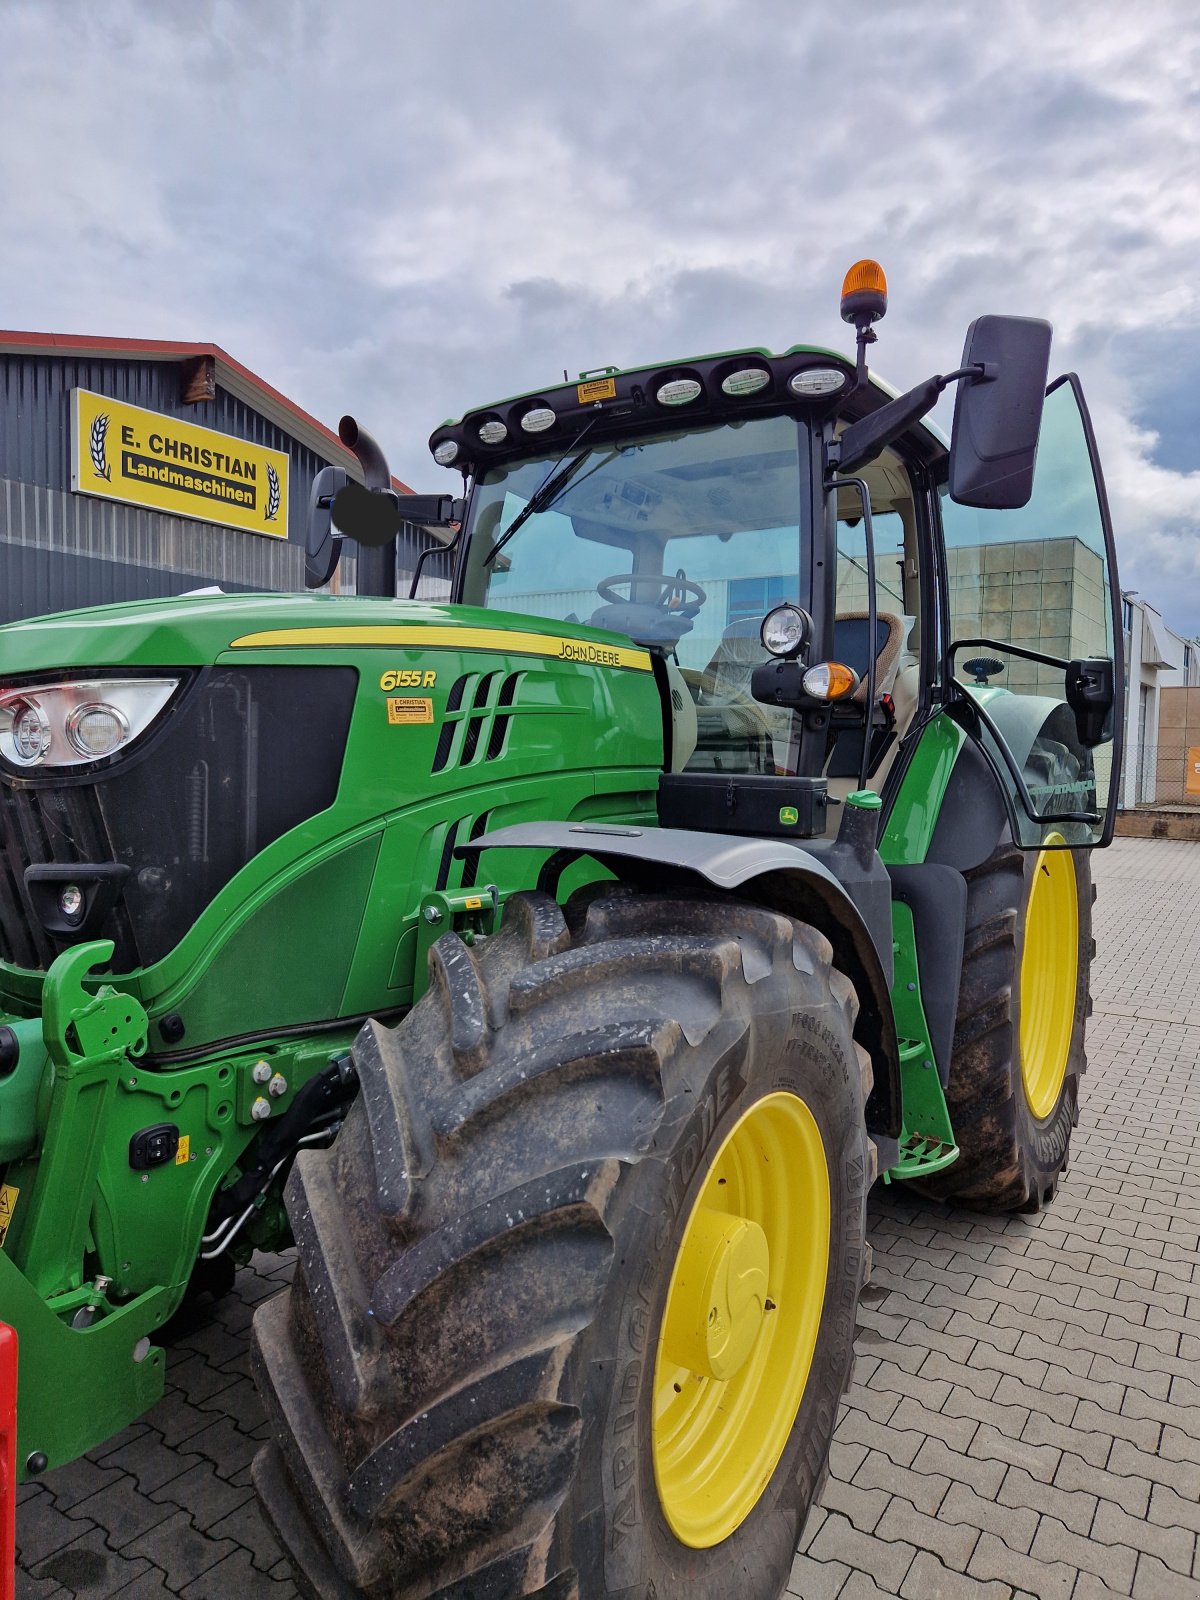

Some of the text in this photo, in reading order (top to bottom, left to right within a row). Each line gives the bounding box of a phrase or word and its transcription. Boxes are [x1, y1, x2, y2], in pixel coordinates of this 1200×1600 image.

[121, 425, 257, 481] E. CHRISTIAN
[127, 456, 254, 505] Landmaschinen
[559, 641, 620, 665] JOHN DEERE
